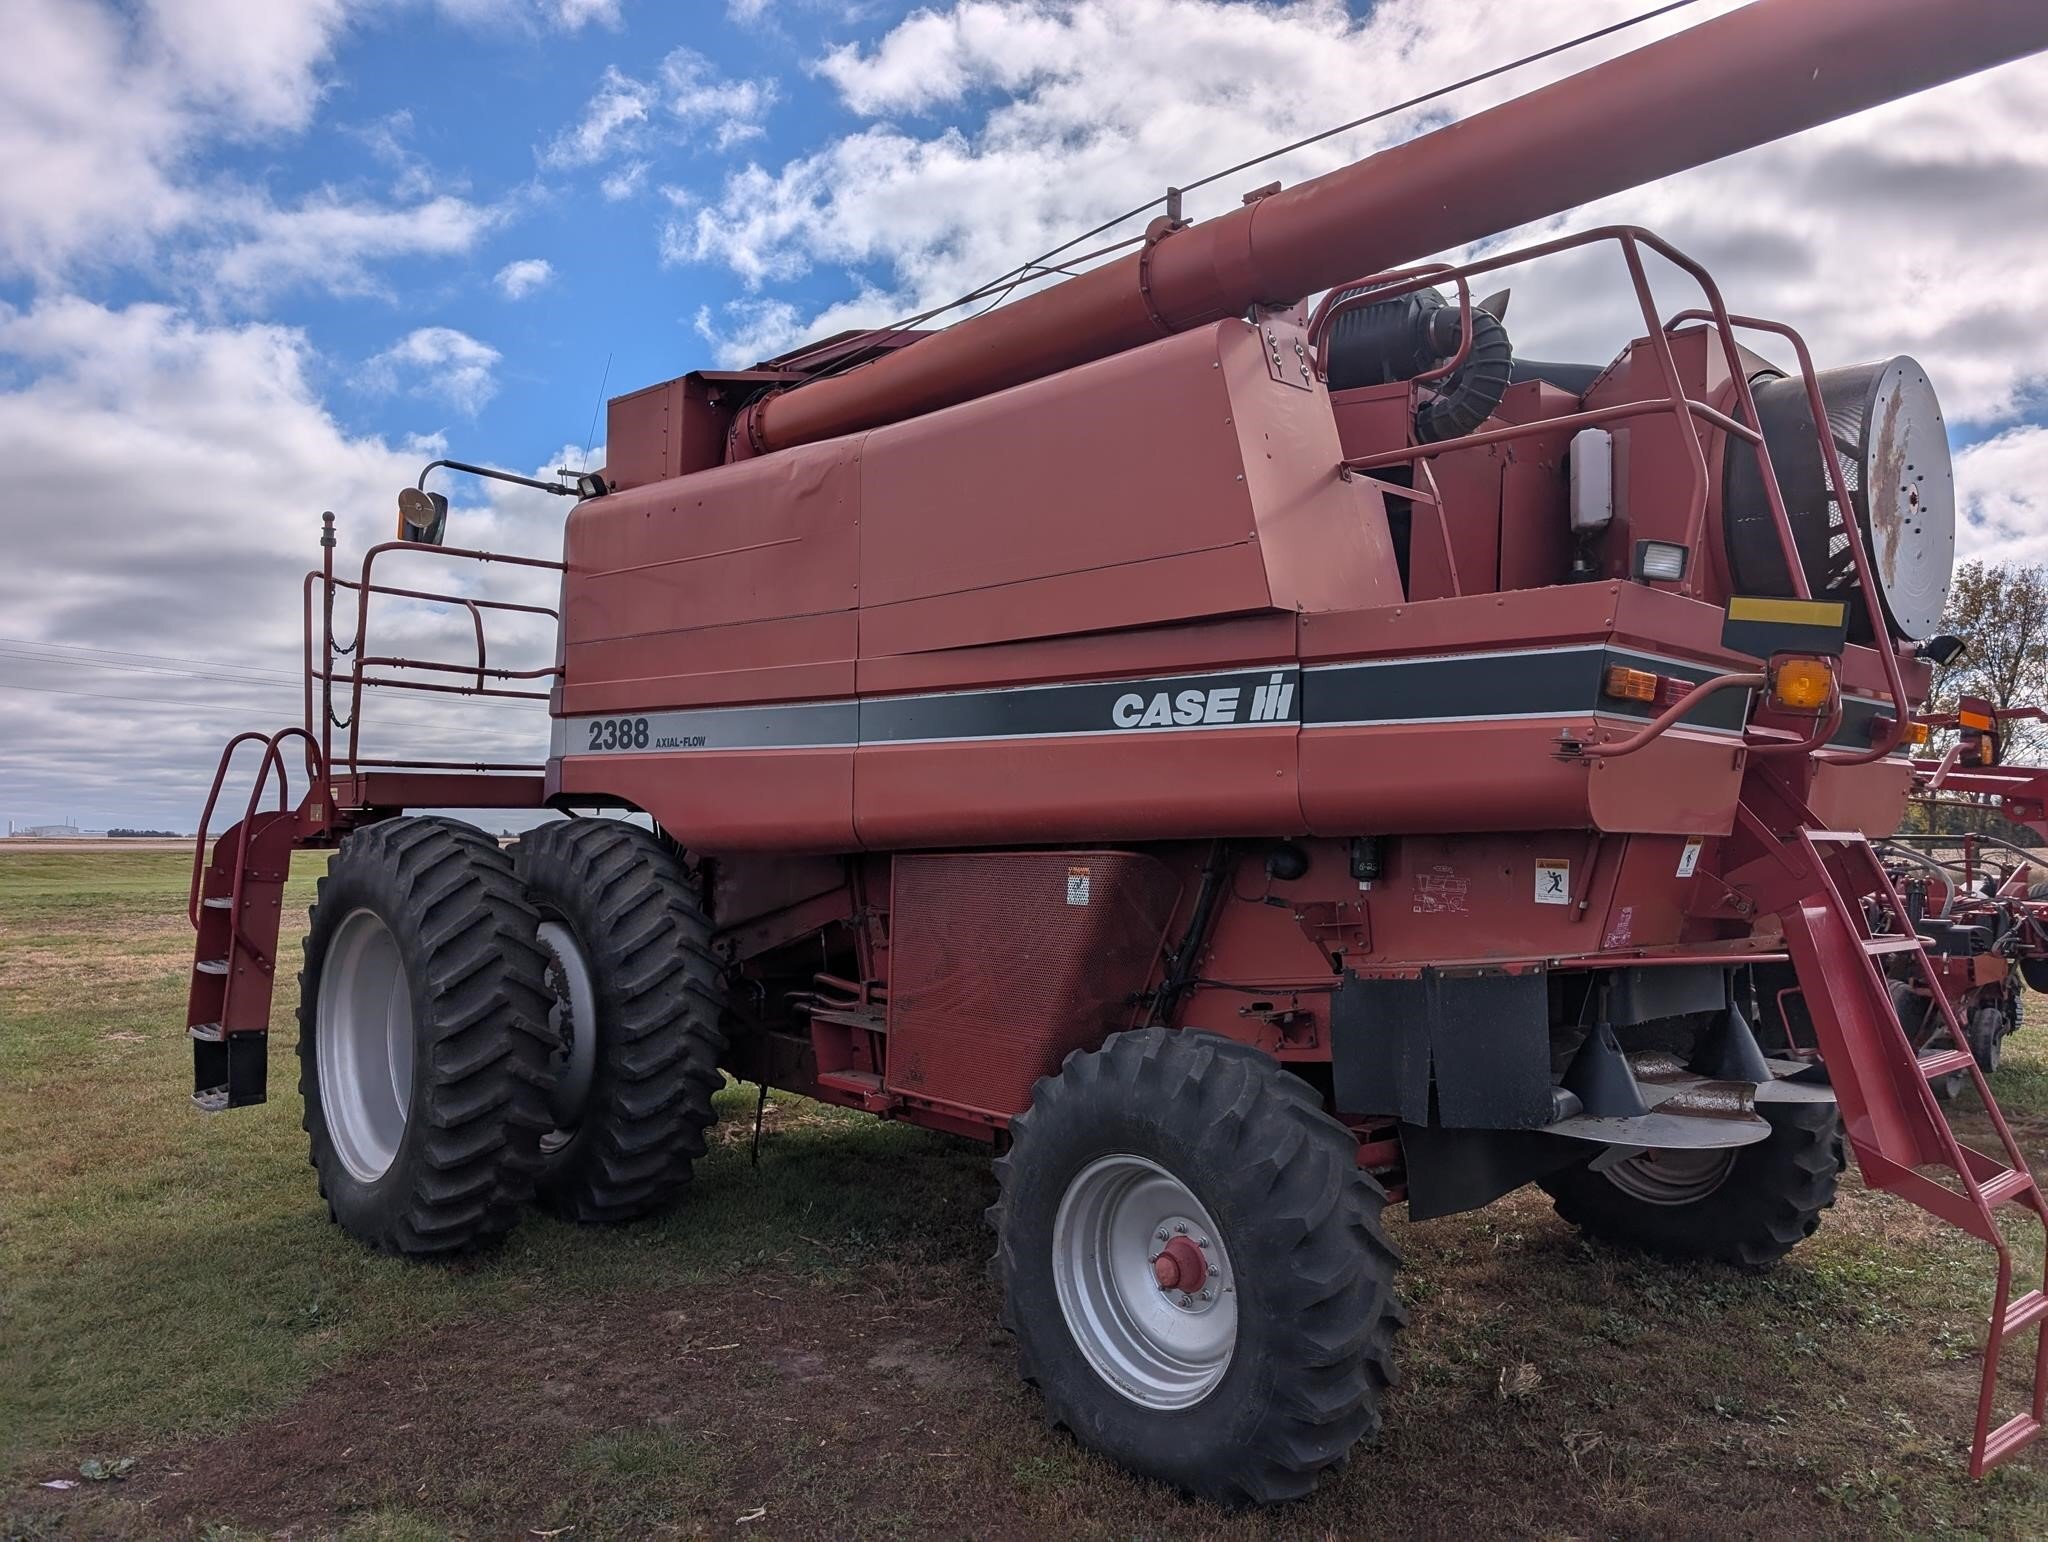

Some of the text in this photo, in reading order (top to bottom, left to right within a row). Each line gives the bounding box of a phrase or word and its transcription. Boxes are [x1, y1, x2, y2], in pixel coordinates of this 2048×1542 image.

[1112, 687, 1241, 728] CASE
[588, 717, 706, 751] 2388 AXIAL-FLOW
